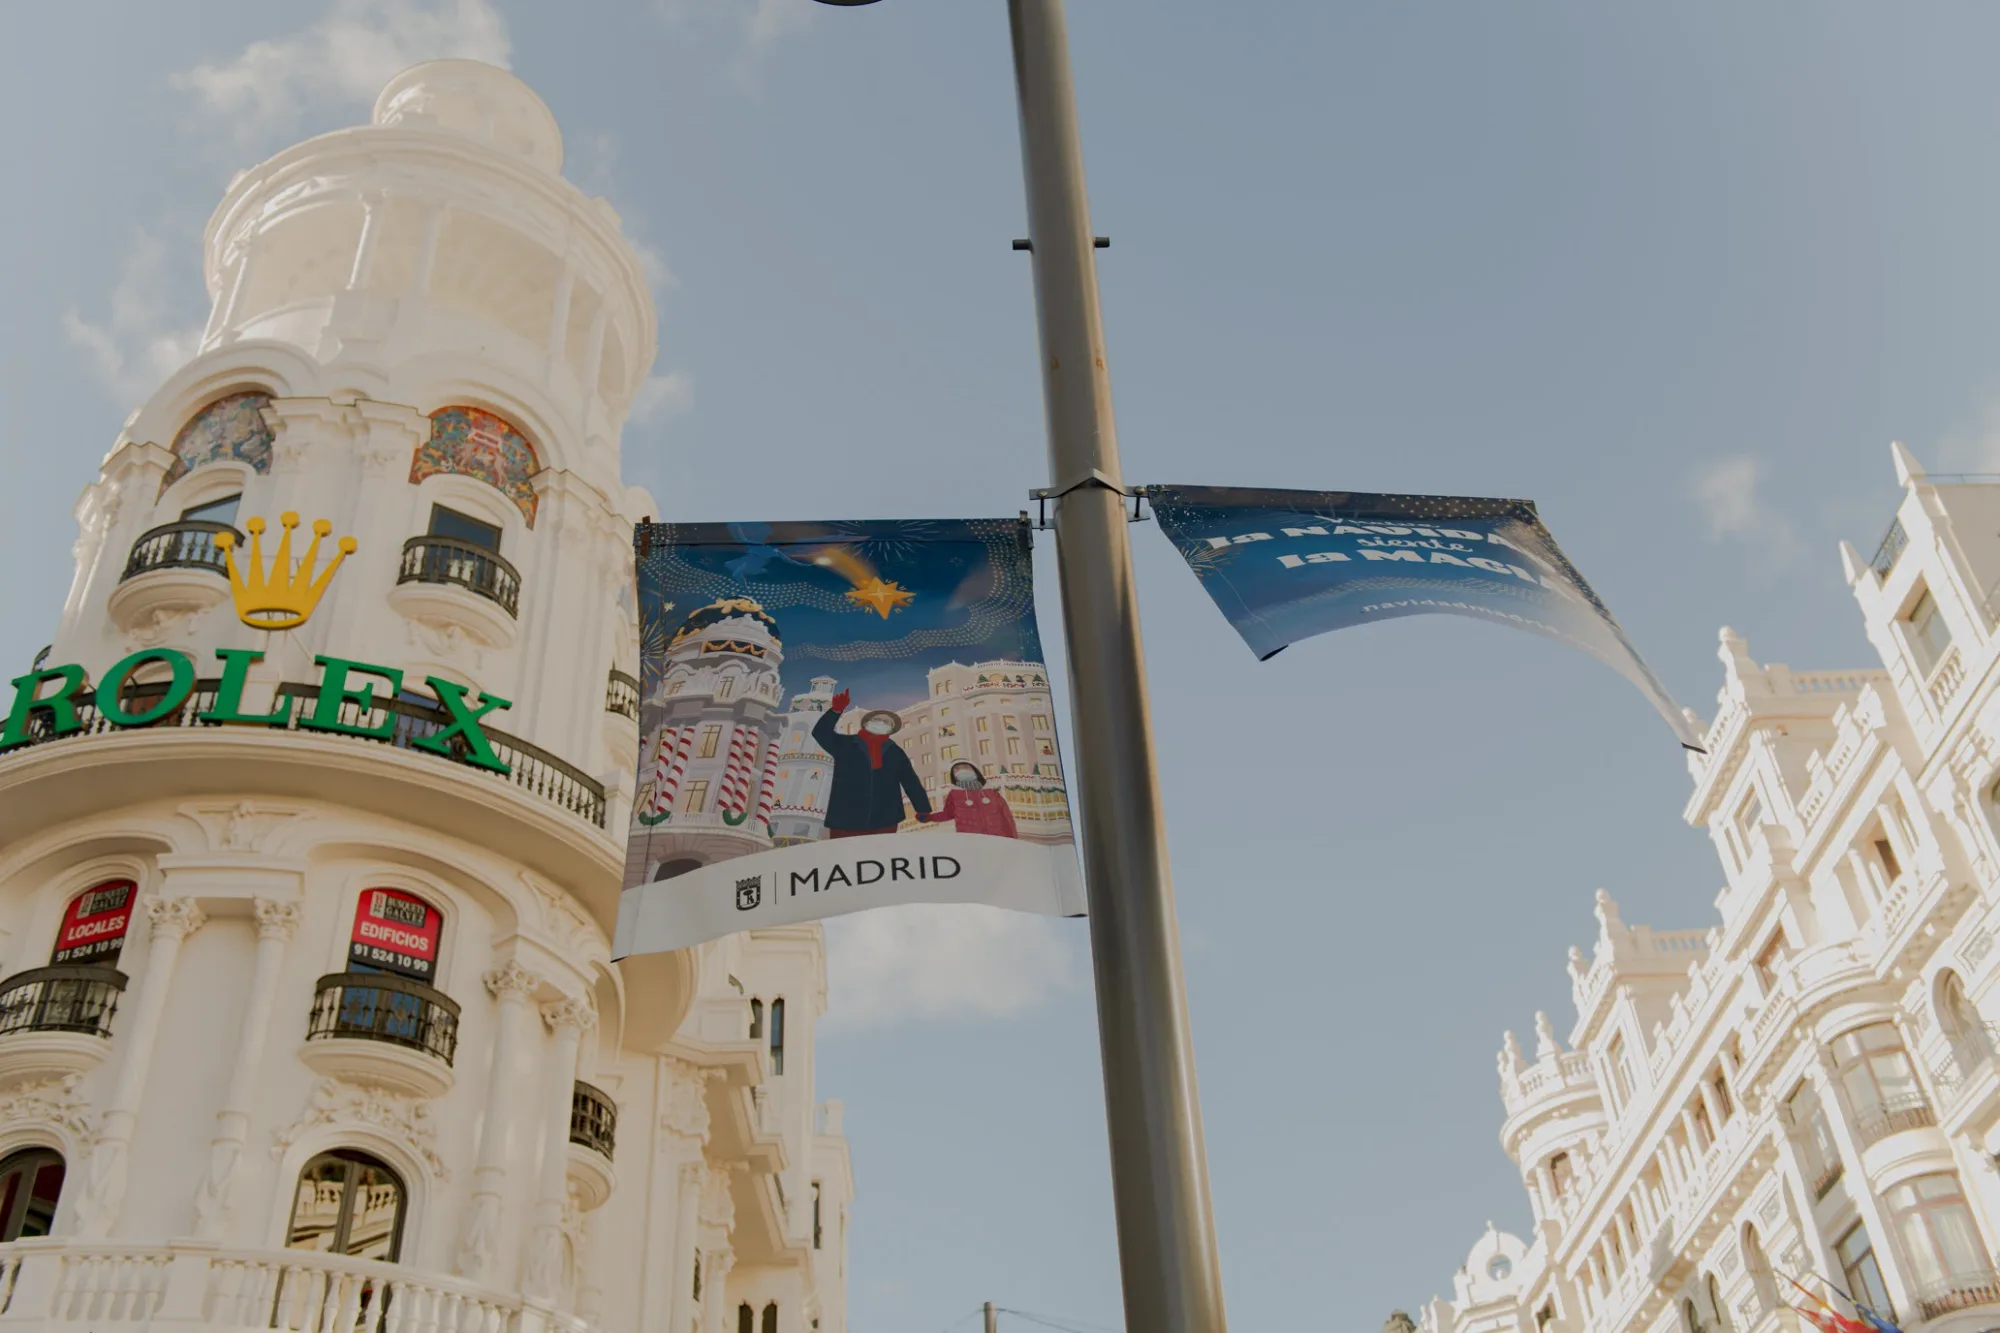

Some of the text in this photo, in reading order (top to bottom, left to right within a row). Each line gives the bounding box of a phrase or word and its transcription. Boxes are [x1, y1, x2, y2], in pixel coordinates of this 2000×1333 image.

[1207, 532, 1275, 549] la
[1356, 536, 1473, 552] siente
[1276, 552, 1352, 569] la
[0, 647, 513, 774] ROLEX
[790, 856, 961, 896] MADRID
[67, 915, 126, 941] LOCALES
[360, 921, 429, 951] EDIFICIOS
[57, 937, 124, 962] 91 524 10 99
[354, 943, 429, 972] 91 524 10 99
